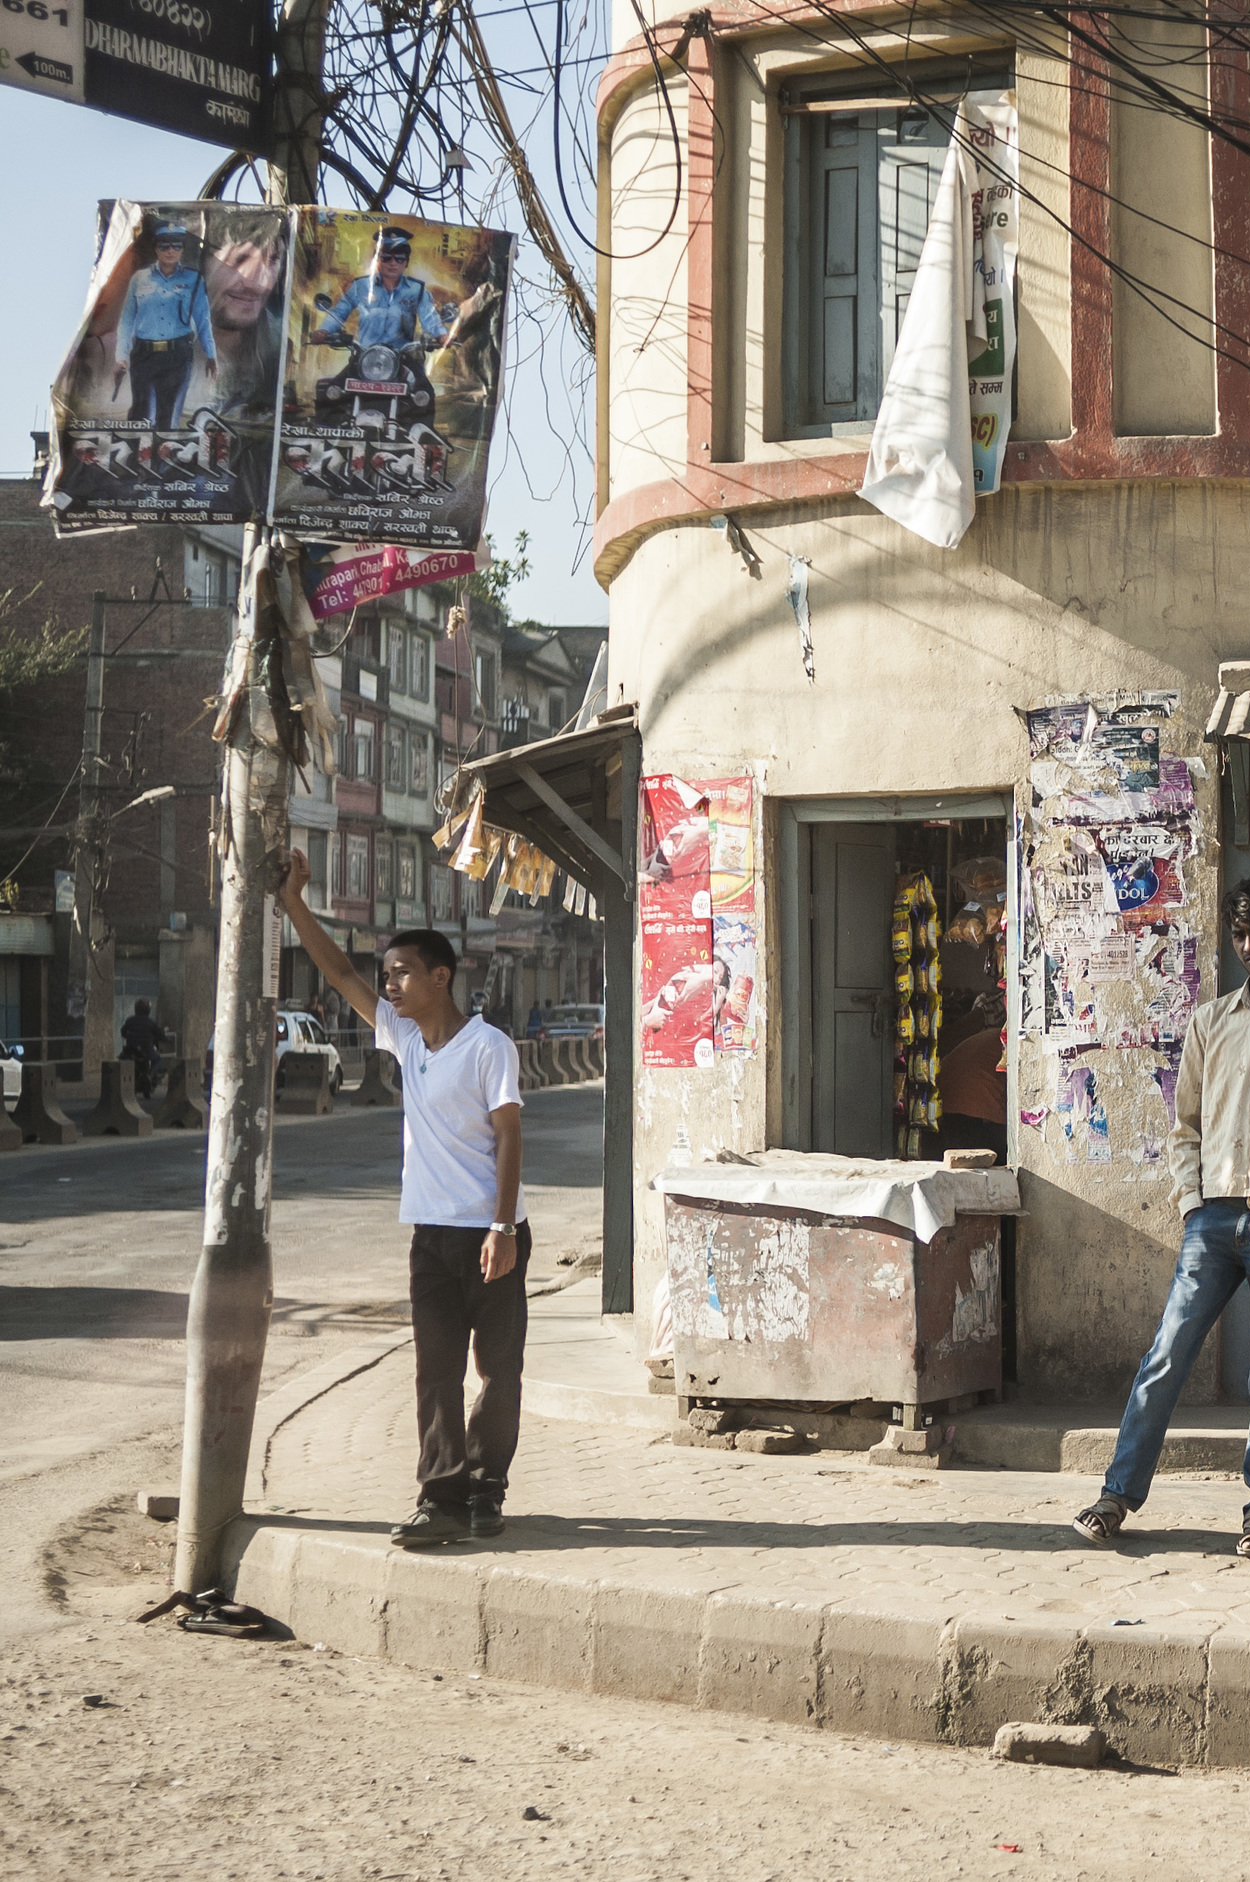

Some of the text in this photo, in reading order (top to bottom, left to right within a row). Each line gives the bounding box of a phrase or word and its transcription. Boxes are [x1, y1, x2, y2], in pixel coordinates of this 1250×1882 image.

[34, 60, 71, 81] 100m.
[218, 62, 261, 103] MARG
[67, 406, 238, 479] काली
[280, 422, 456, 492] काली
[318, 590, 349, 610] Tel:
[395, 554, 459, 582] 4490670
